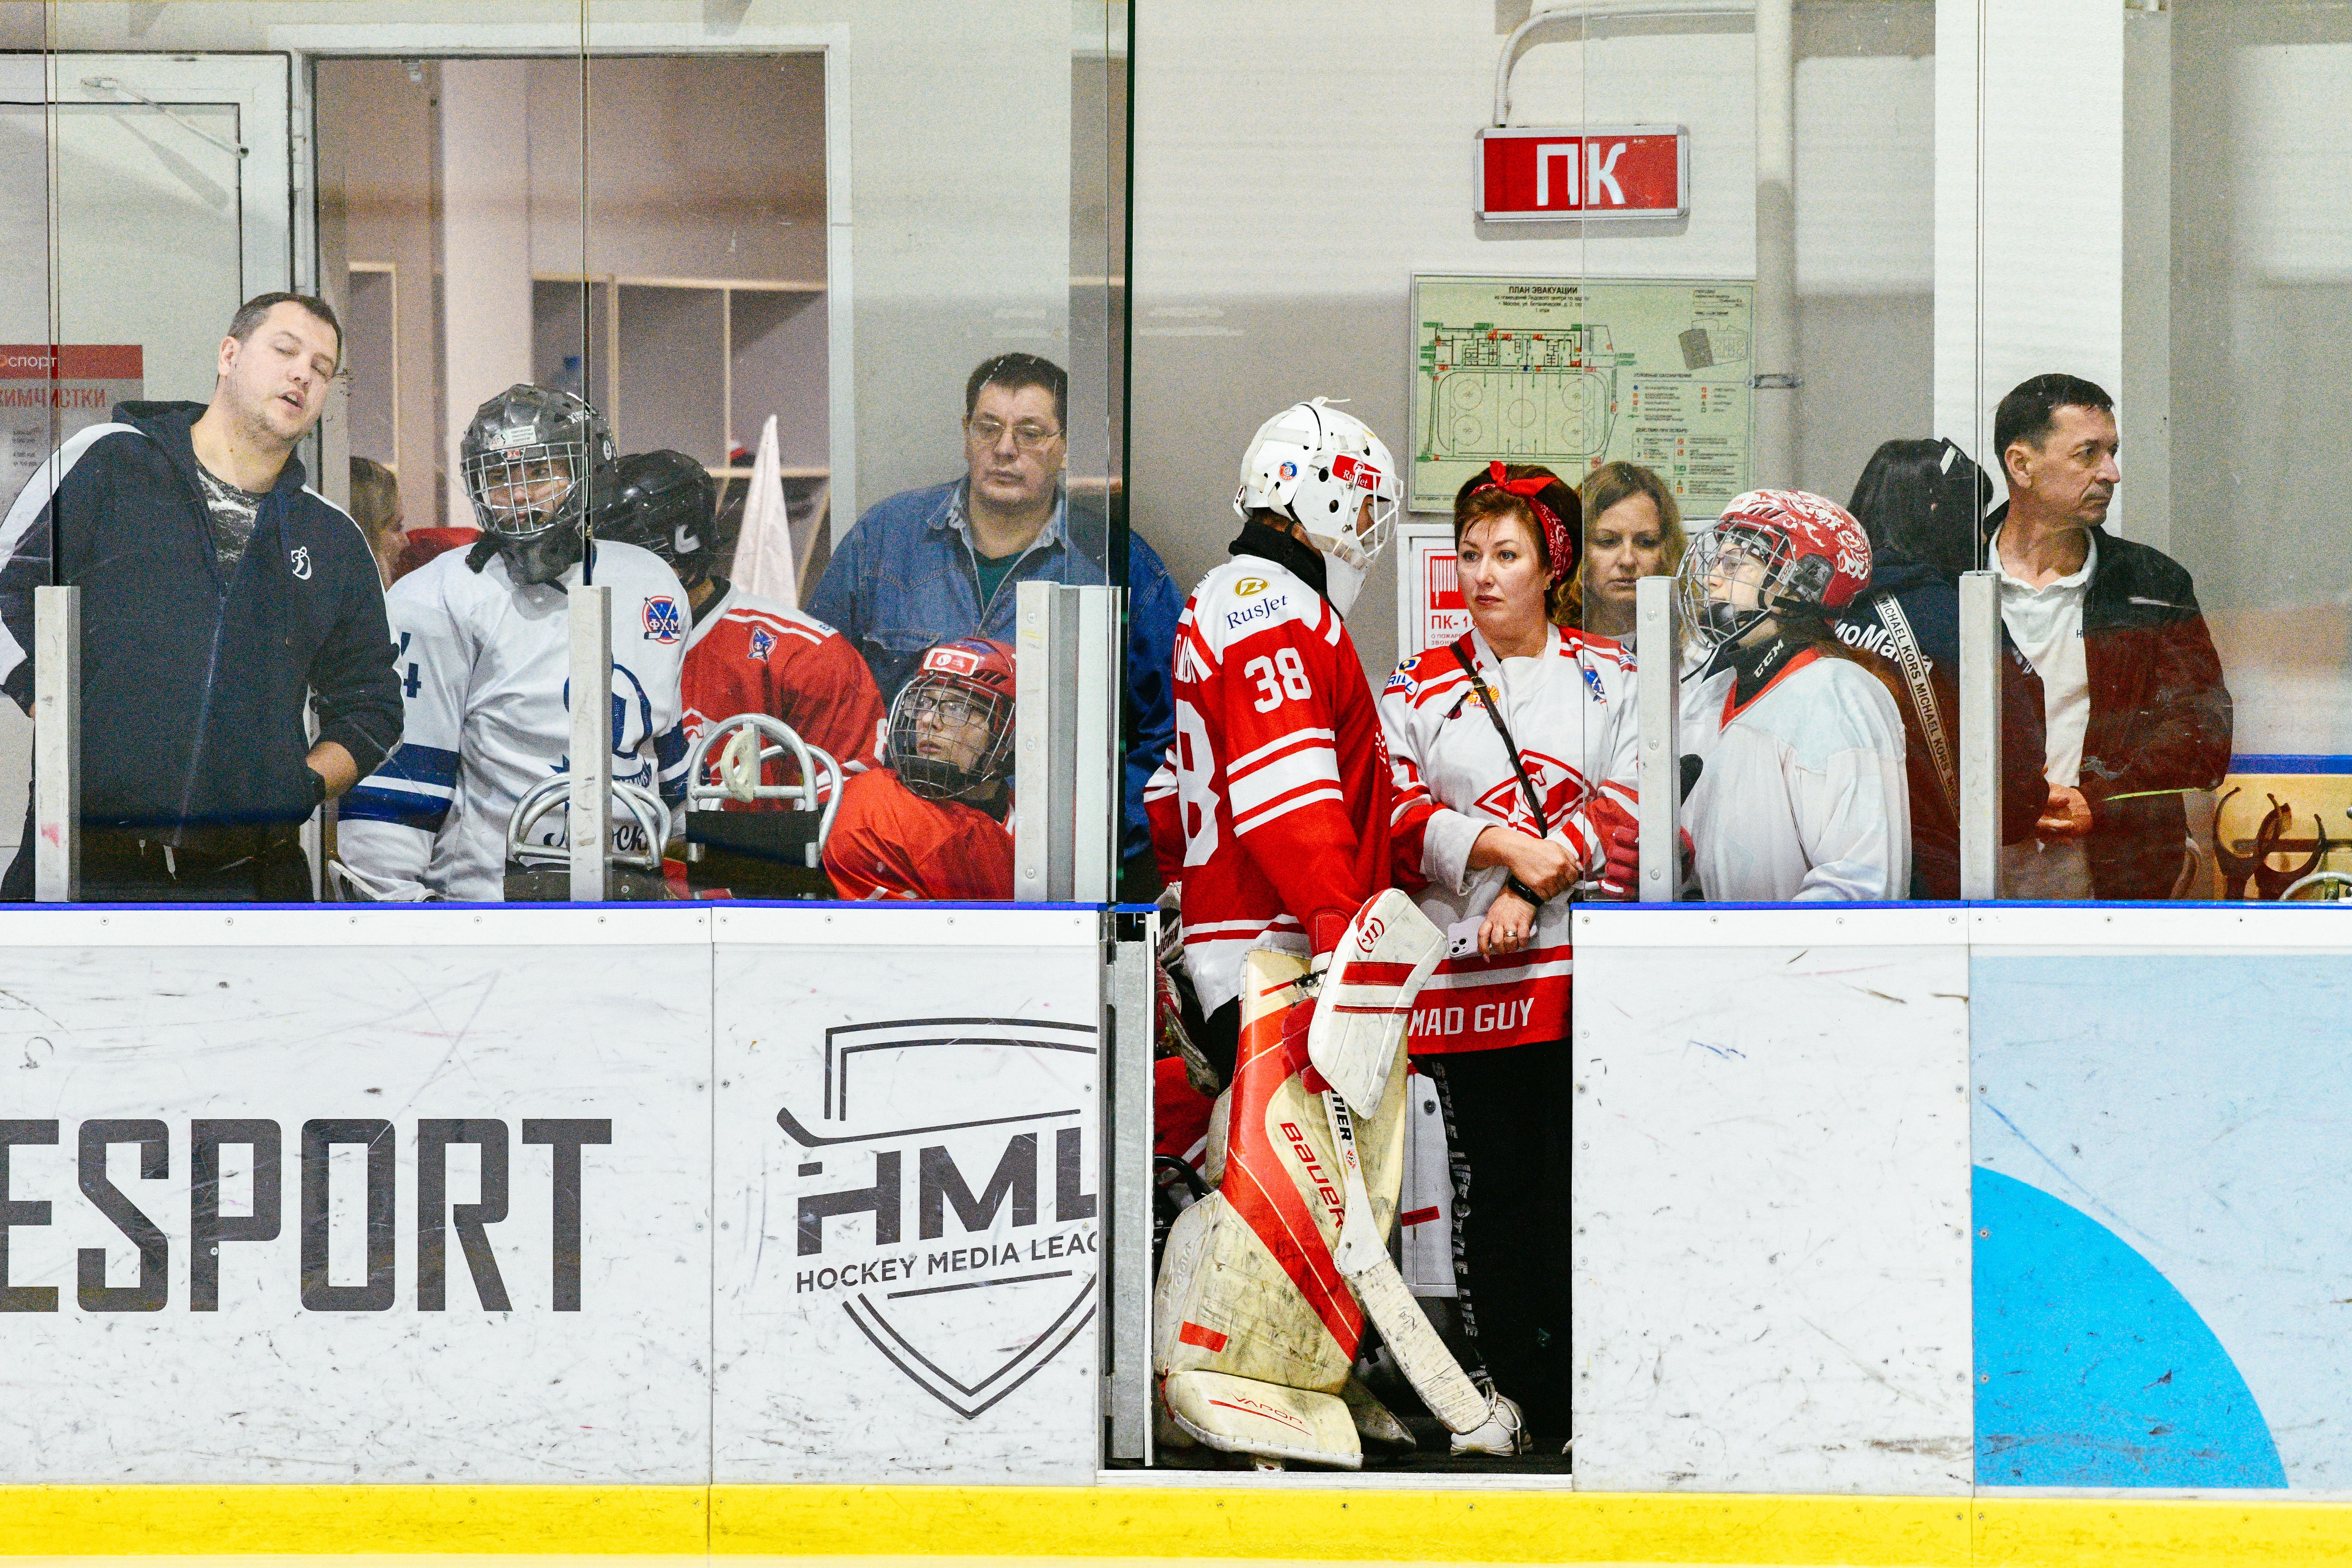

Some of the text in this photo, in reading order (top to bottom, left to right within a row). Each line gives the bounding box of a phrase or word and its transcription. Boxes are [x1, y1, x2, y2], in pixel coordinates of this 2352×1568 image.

[1537, 143, 1626, 205] ПК
[1343, 469, 1368, 487] RuJet
[1226, 595, 1288, 630] RusJet
[1244, 647, 1312, 713] 38
[1754, 639, 1784, 678] CCM
[1879, 596, 1908, 643] MICHAEL
[1901, 645, 1922, 680] KORS
[1914, 683, 1938, 737] MICHAEL
[1407, 997, 1535, 1036] MAD GUY
[1330, 1090, 1352, 1141] TIER
[0, 1119, 612, 1312] ESPORT
[797, 1127, 1097, 1257] HML
[797, 1255, 918, 1294] HOCKEY
[928, 1242, 1020, 1275] MEDIA
